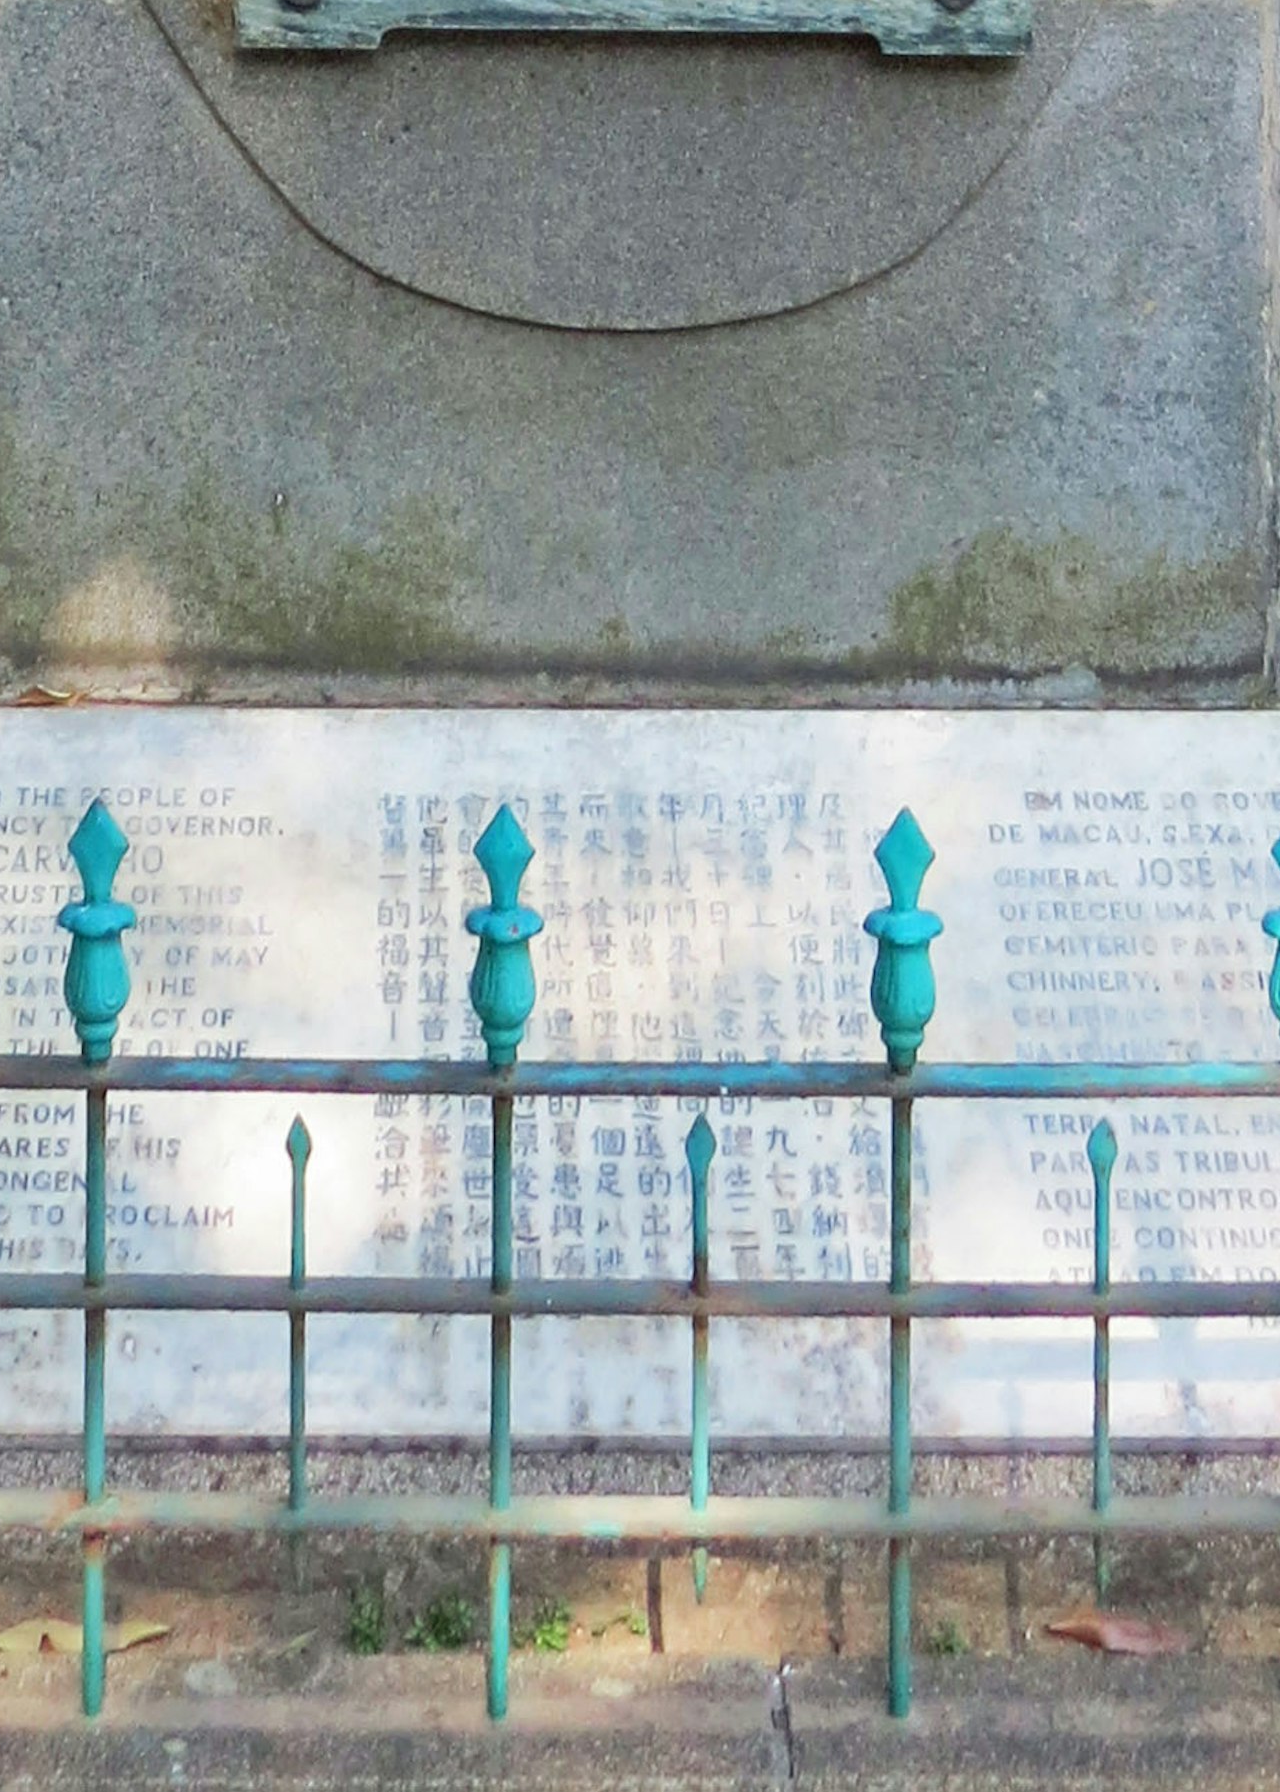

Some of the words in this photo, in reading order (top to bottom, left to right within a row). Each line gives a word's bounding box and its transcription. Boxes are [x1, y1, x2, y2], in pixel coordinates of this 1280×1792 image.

[15, 786, 76, 808] THE
[199, 788, 237, 808] OF
[1072, 791, 1151, 812] NOME
[987, 824, 1026, 845] DE
[992, 866, 1120, 888] GENERAL
[1135, 849, 1218, 888] JOSÉ
[130, 885, 164, 906] OF
[176, 885, 246, 906] THIS
[1153, 901, 1216, 922] UMA
[165, 946, 203, 967] OF
[209, 946, 270, 967] MAY
[200, 1009, 237, 1028] OF
[133, 1138, 183, 1160] HIS
[1124, 1151, 1161, 1173] AS
[28, 1205, 66, 1225] TO
